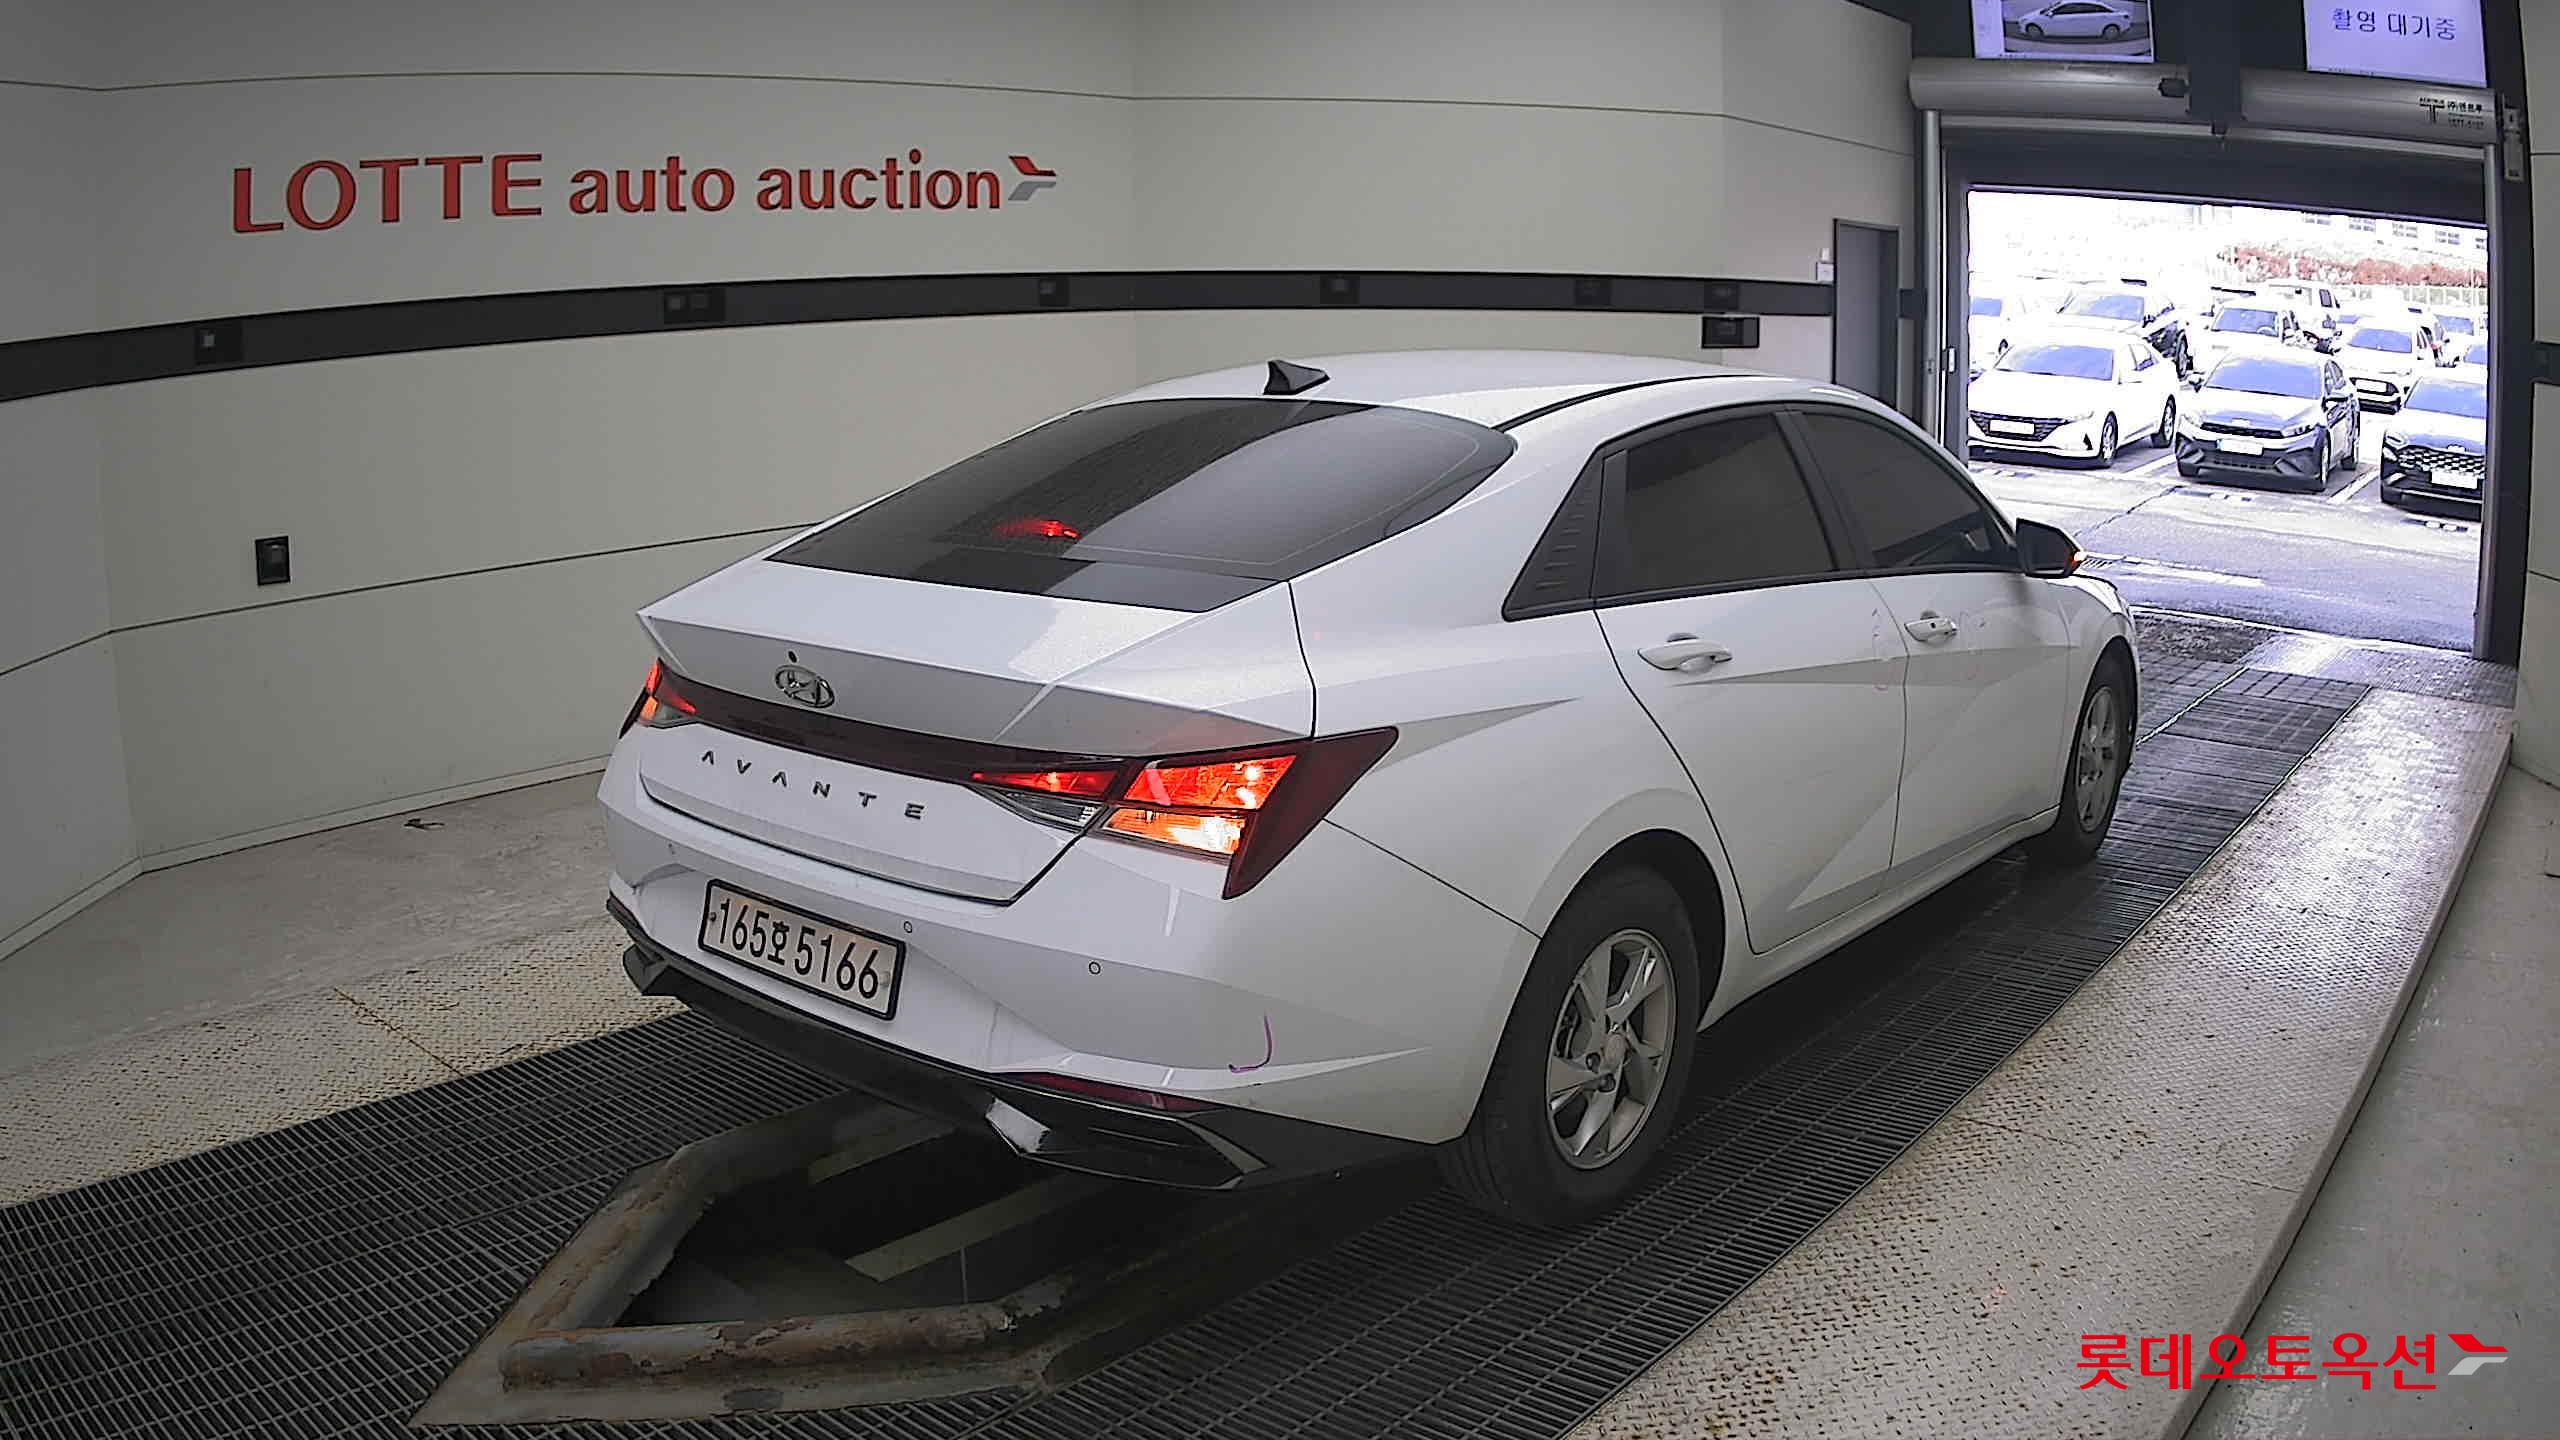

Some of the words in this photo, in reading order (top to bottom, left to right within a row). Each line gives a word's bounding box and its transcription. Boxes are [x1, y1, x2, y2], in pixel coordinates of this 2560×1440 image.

[2332, 8, 2376, 33] 촬영
[2387, 13, 2457, 41] 대기중
[234, 154, 543, 233] LOTTE
[569, 155, 734, 214] auto
[758, 148, 1001, 211] auction
[701, 750, 925, 820] AVANTE
